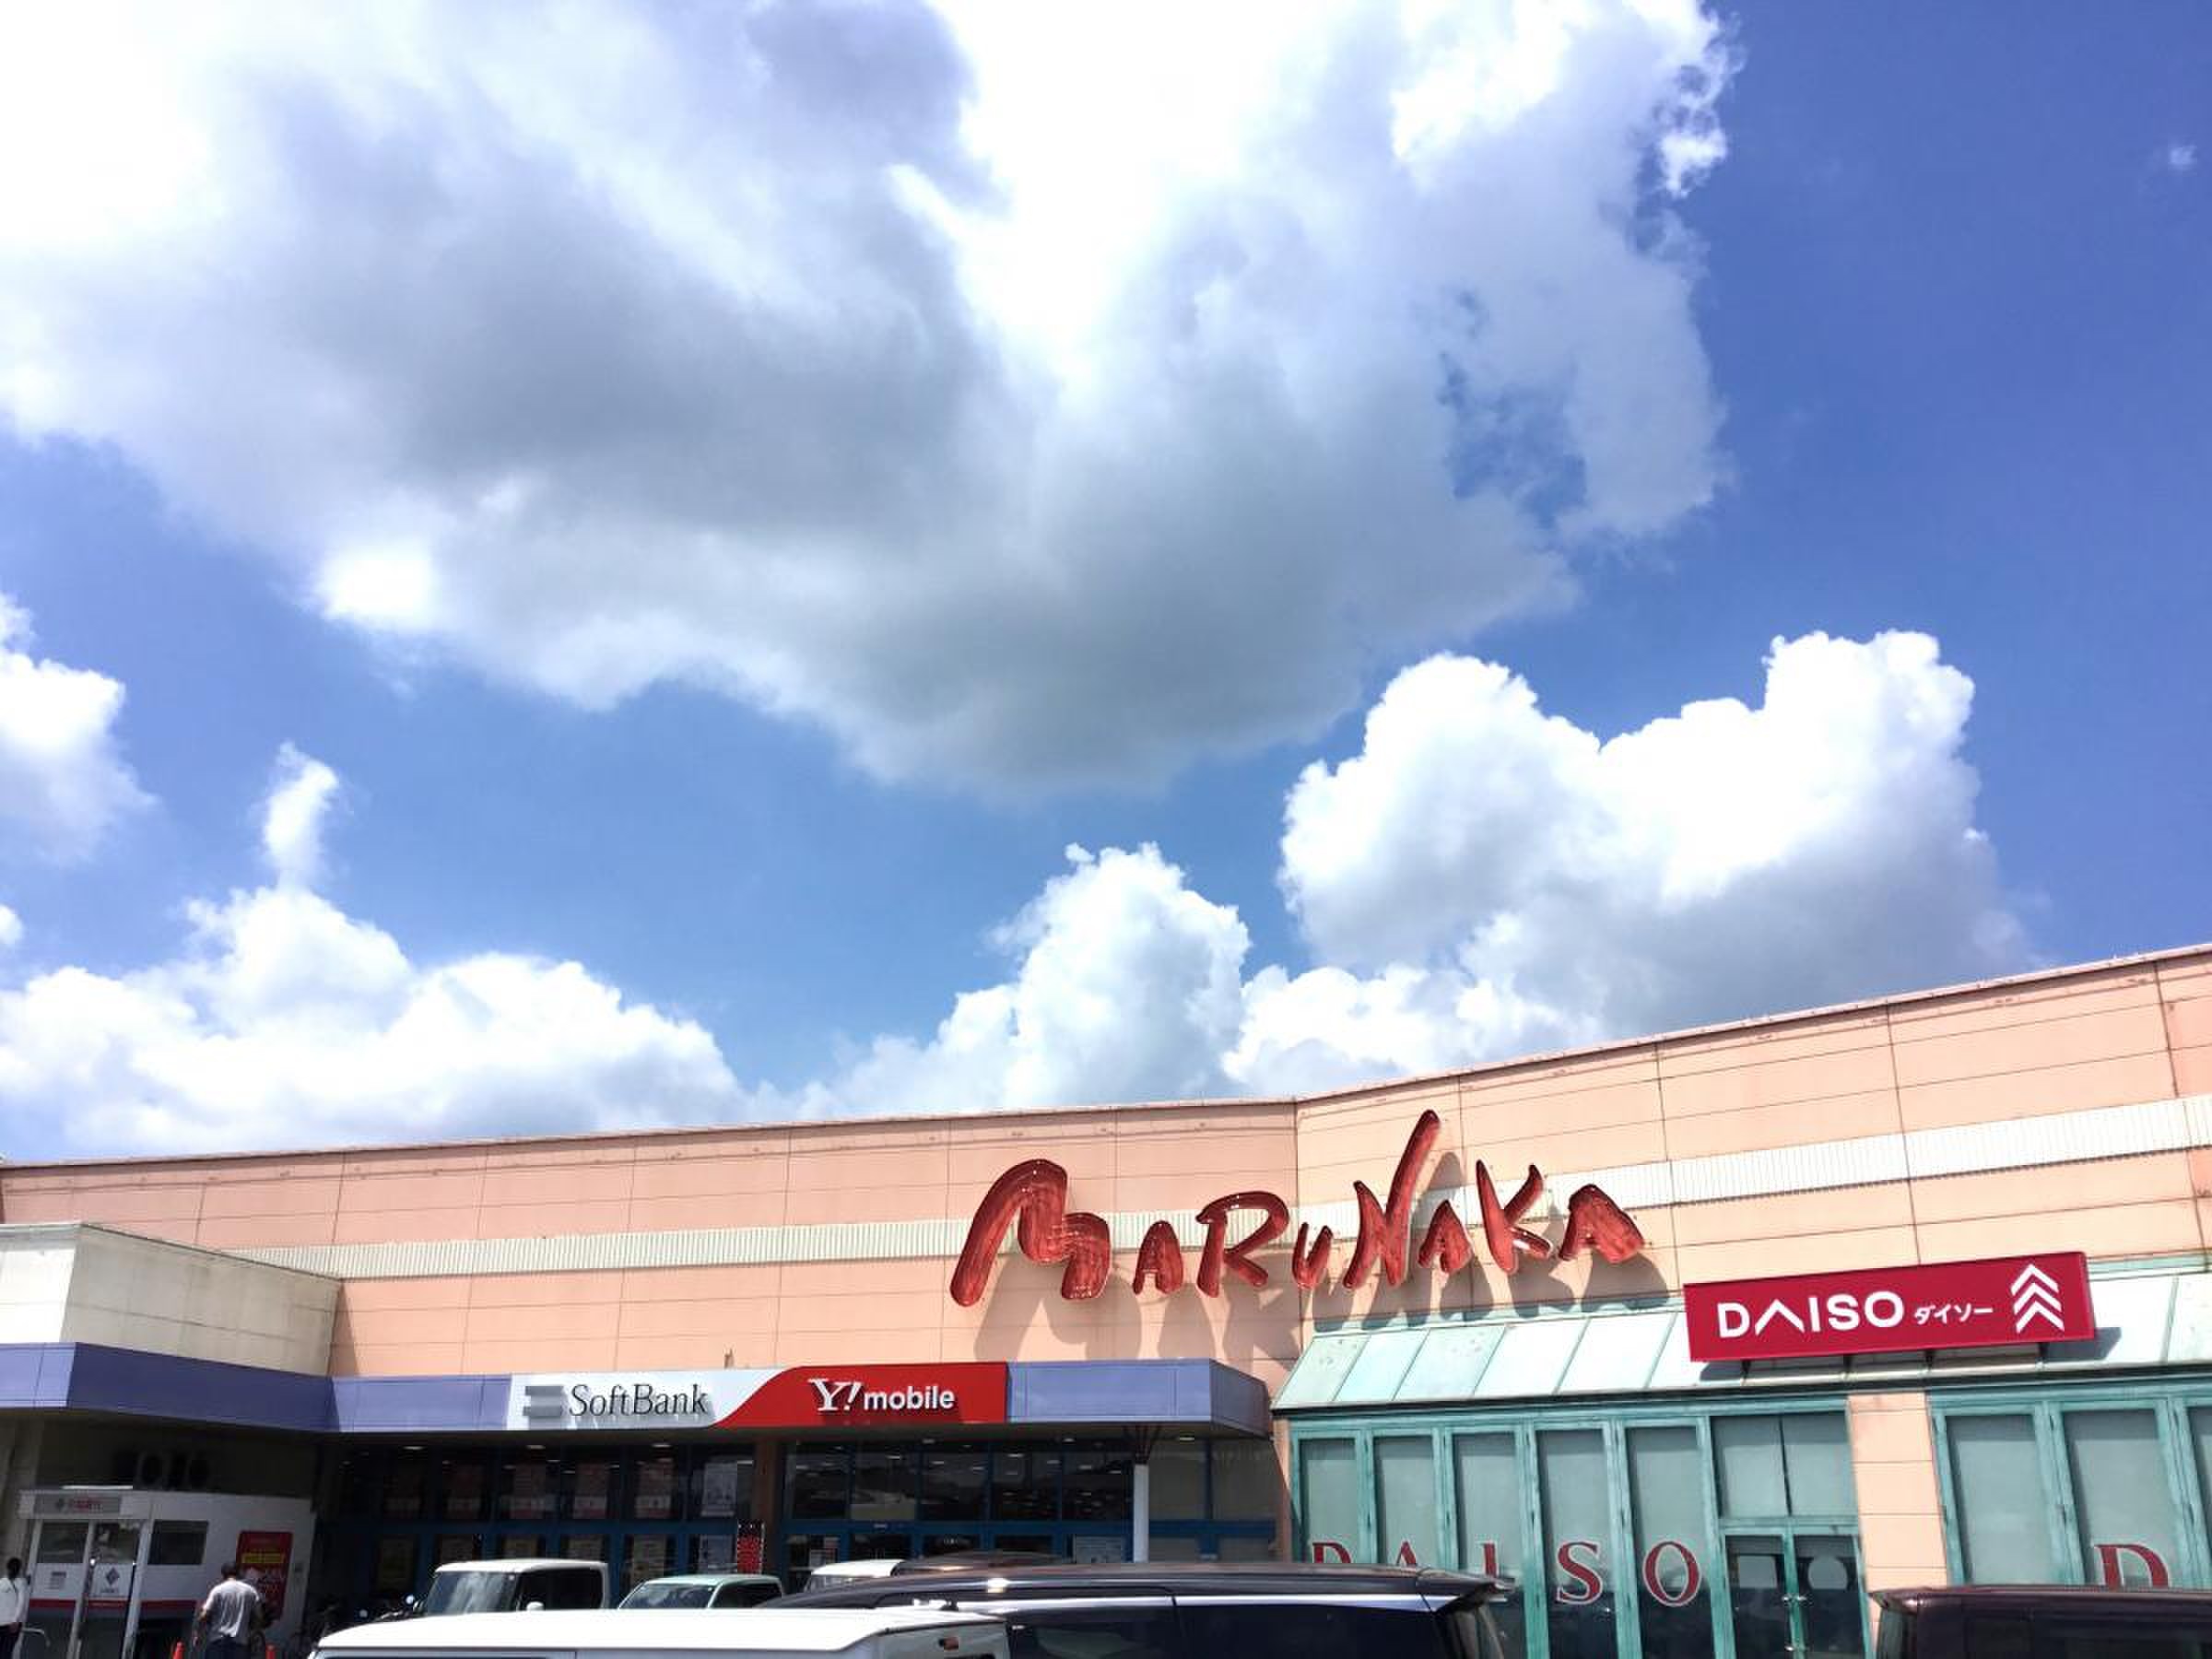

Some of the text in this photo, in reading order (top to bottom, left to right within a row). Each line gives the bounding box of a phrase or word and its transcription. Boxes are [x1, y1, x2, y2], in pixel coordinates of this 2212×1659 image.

[950, 1110, 1644, 1307] MARUNAKA
[1717, 1291, 1904, 1338] DAISO
[1913, 1303, 1994, 1325] ダイソー
[569, 1383, 707, 1417] SoftBank
